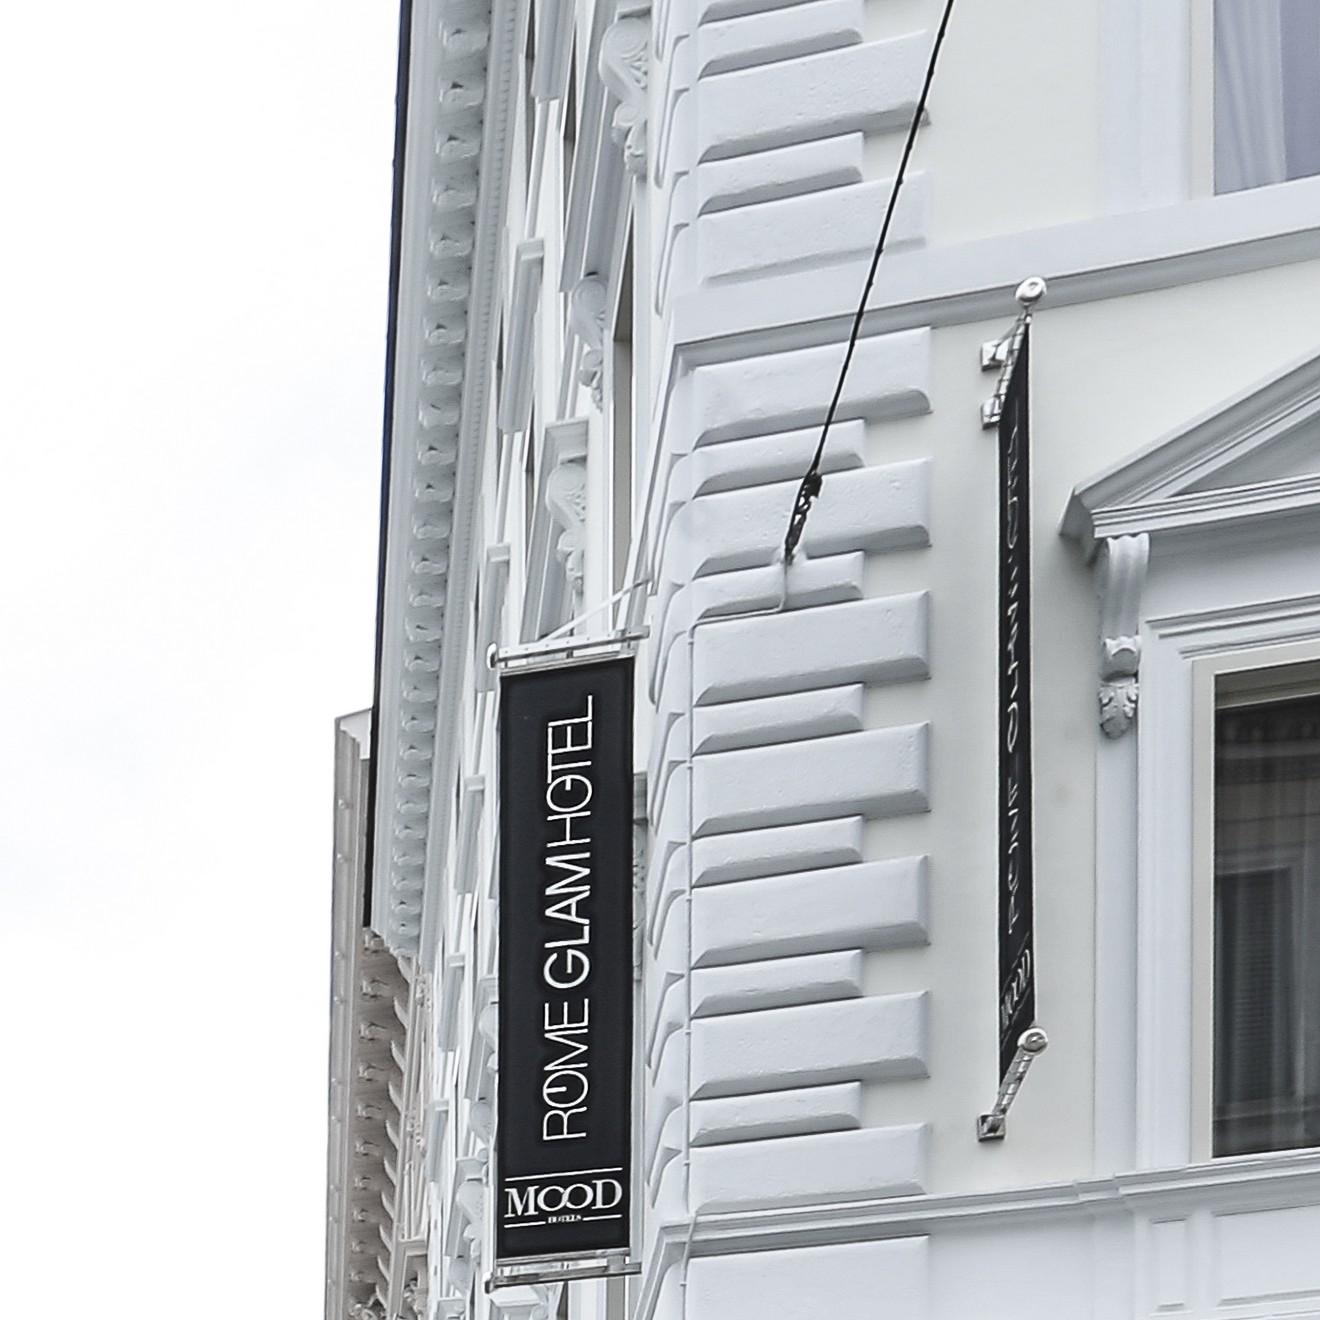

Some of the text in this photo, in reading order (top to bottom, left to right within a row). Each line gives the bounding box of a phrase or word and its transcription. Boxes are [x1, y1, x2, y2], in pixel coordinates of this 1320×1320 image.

[543, 998, 589, 1141] ROME
[504, 1178, 622, 1218] MOOD
[547, 1214, 582, 1224] HOTELS
